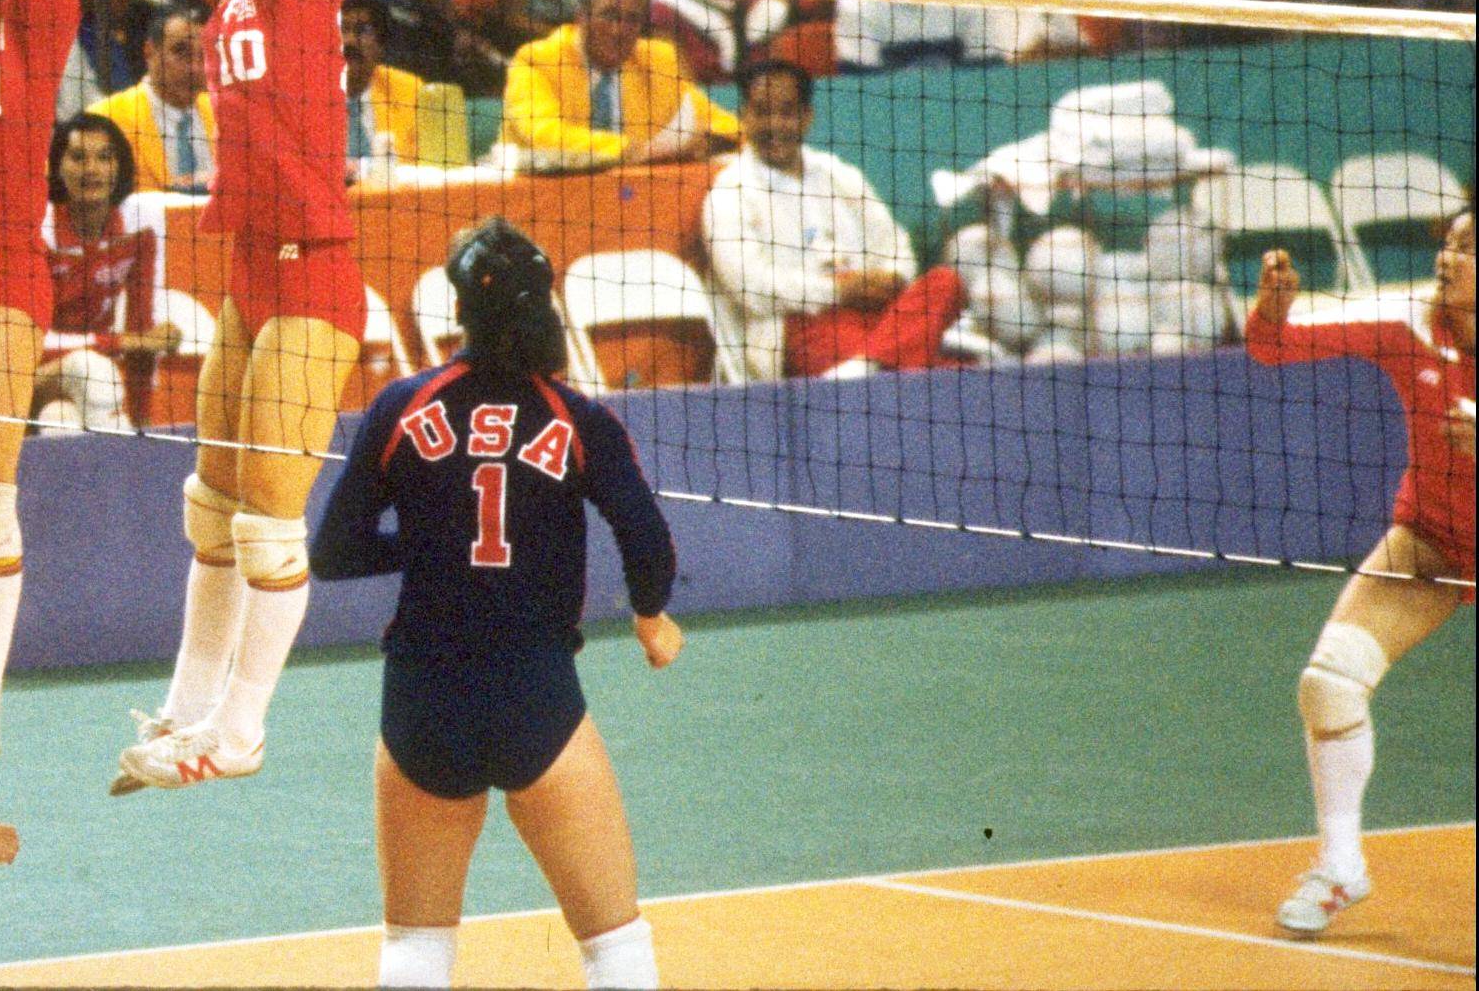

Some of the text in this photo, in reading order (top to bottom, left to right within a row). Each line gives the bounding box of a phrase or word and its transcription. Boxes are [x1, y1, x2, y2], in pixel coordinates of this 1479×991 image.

[214, 29, 268, 87] 10
[400, 400, 574, 481] USA
[470, 463, 512, 568] 1
